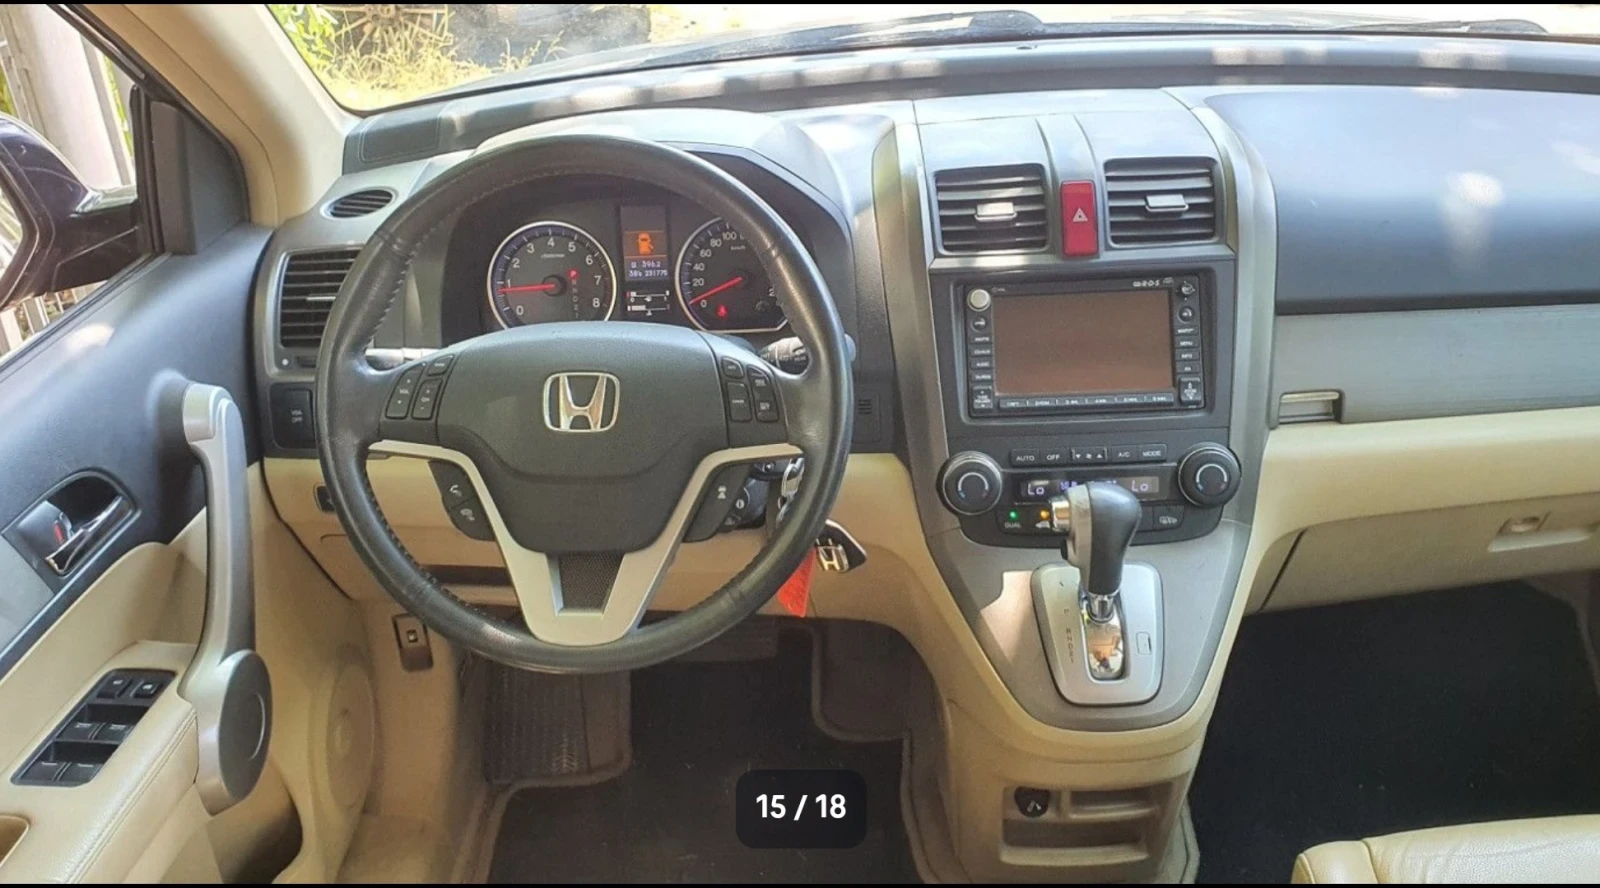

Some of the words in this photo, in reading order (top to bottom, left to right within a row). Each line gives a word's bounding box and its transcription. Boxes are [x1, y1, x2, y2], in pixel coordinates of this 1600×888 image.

[722, 231, 737, 240] 100
[547, 238, 555, 247] 4
[568, 242, 576, 252] 5
[710, 239, 721, 247] 80
[527, 243, 535, 253] 3
[700, 249, 712, 257] 60
[512, 258, 520, 268] 2
[586, 255, 593, 265] 6
[693, 263, 705, 271] 40
[507, 279, 511, 288] 1
[594, 275, 602, 285] 7
[692, 278, 704, 286] 20
[592, 298, 600, 307] 8
[700, 300, 707, 308] 0
[516, 305, 524, 315] 0
[1027, 483, 1045, 495] Lo
[1131, 480, 1149, 492] Lo
